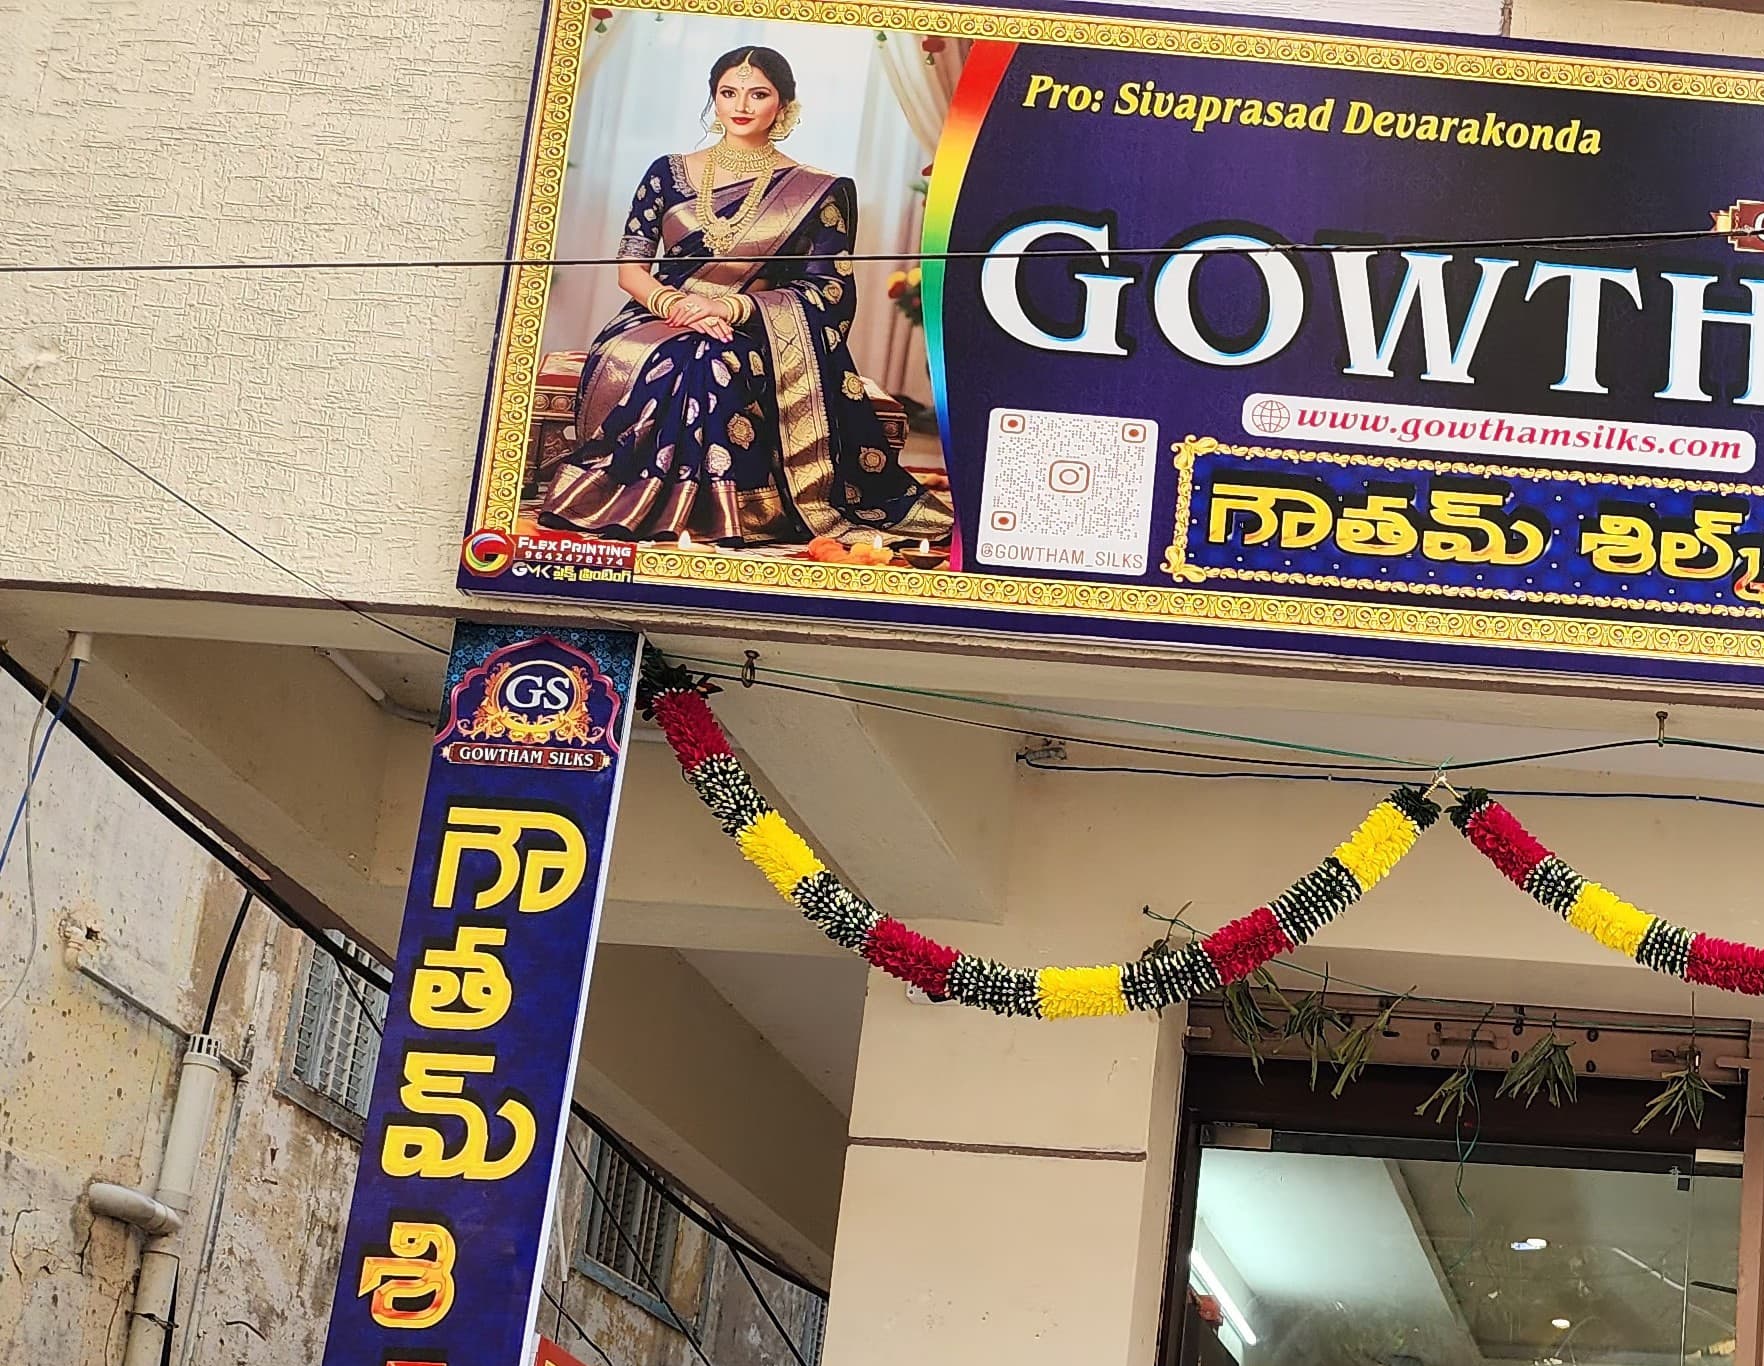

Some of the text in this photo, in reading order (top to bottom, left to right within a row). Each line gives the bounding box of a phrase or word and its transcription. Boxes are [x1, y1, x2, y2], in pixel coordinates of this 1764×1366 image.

[1022, 74, 1602, 155] Pro: Sivaprasad Devarakonda
[1296, 404, 1743, 462] www.gowthamsilks.com
[1206, 480, 1548, 567] గౌతమ్
[518, 536, 632, 557] FLEX PRINTING
[524, 550, 624, 567] 9642478174
[980, 542, 1143, 570] @GOWTHAM_SILKS
[504, 675, 570, 711] GS
[458, 743, 595, 769] GOWTHAM SILKS
